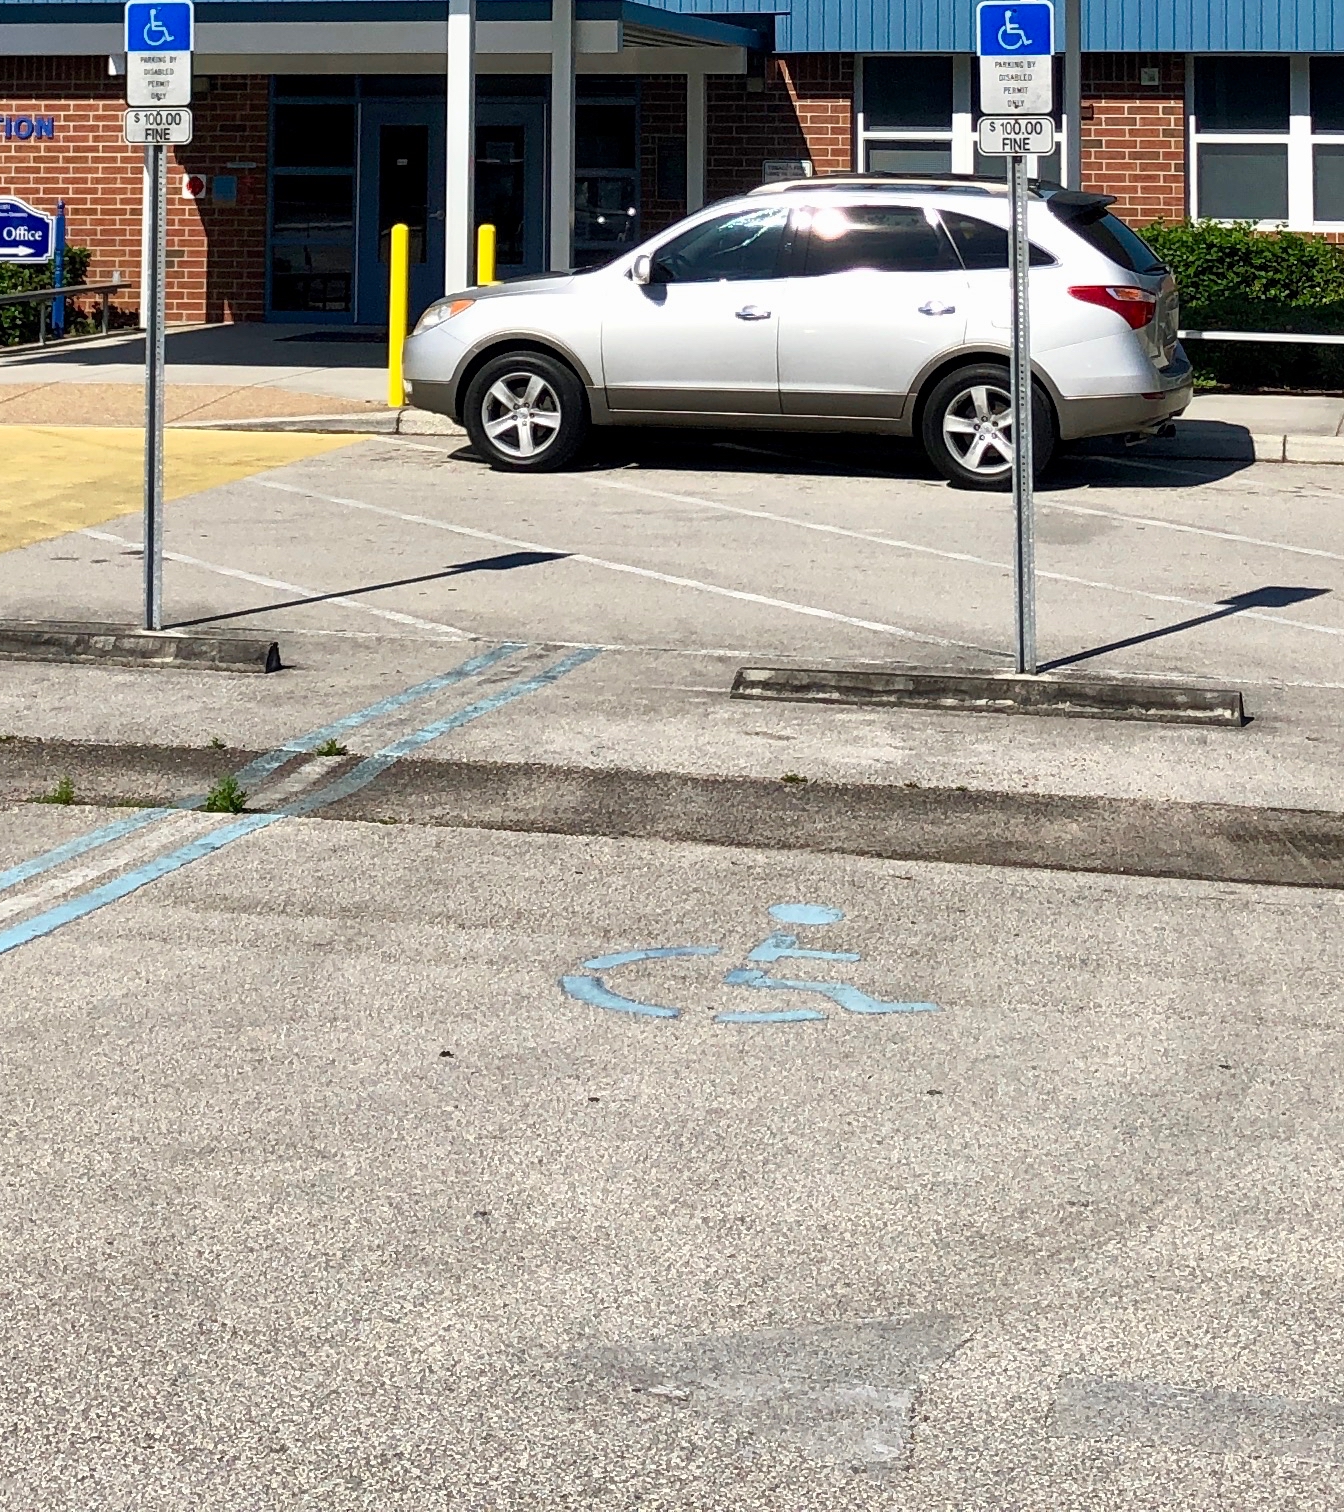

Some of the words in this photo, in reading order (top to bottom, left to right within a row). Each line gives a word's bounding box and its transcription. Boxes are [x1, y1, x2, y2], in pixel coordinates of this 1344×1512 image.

[147, 80, 170, 88] PERMIT
[144, 128, 171, 140] FINE
[1002, 137, 1031, 151] FINE
[2, 225, 43, 240] Office
